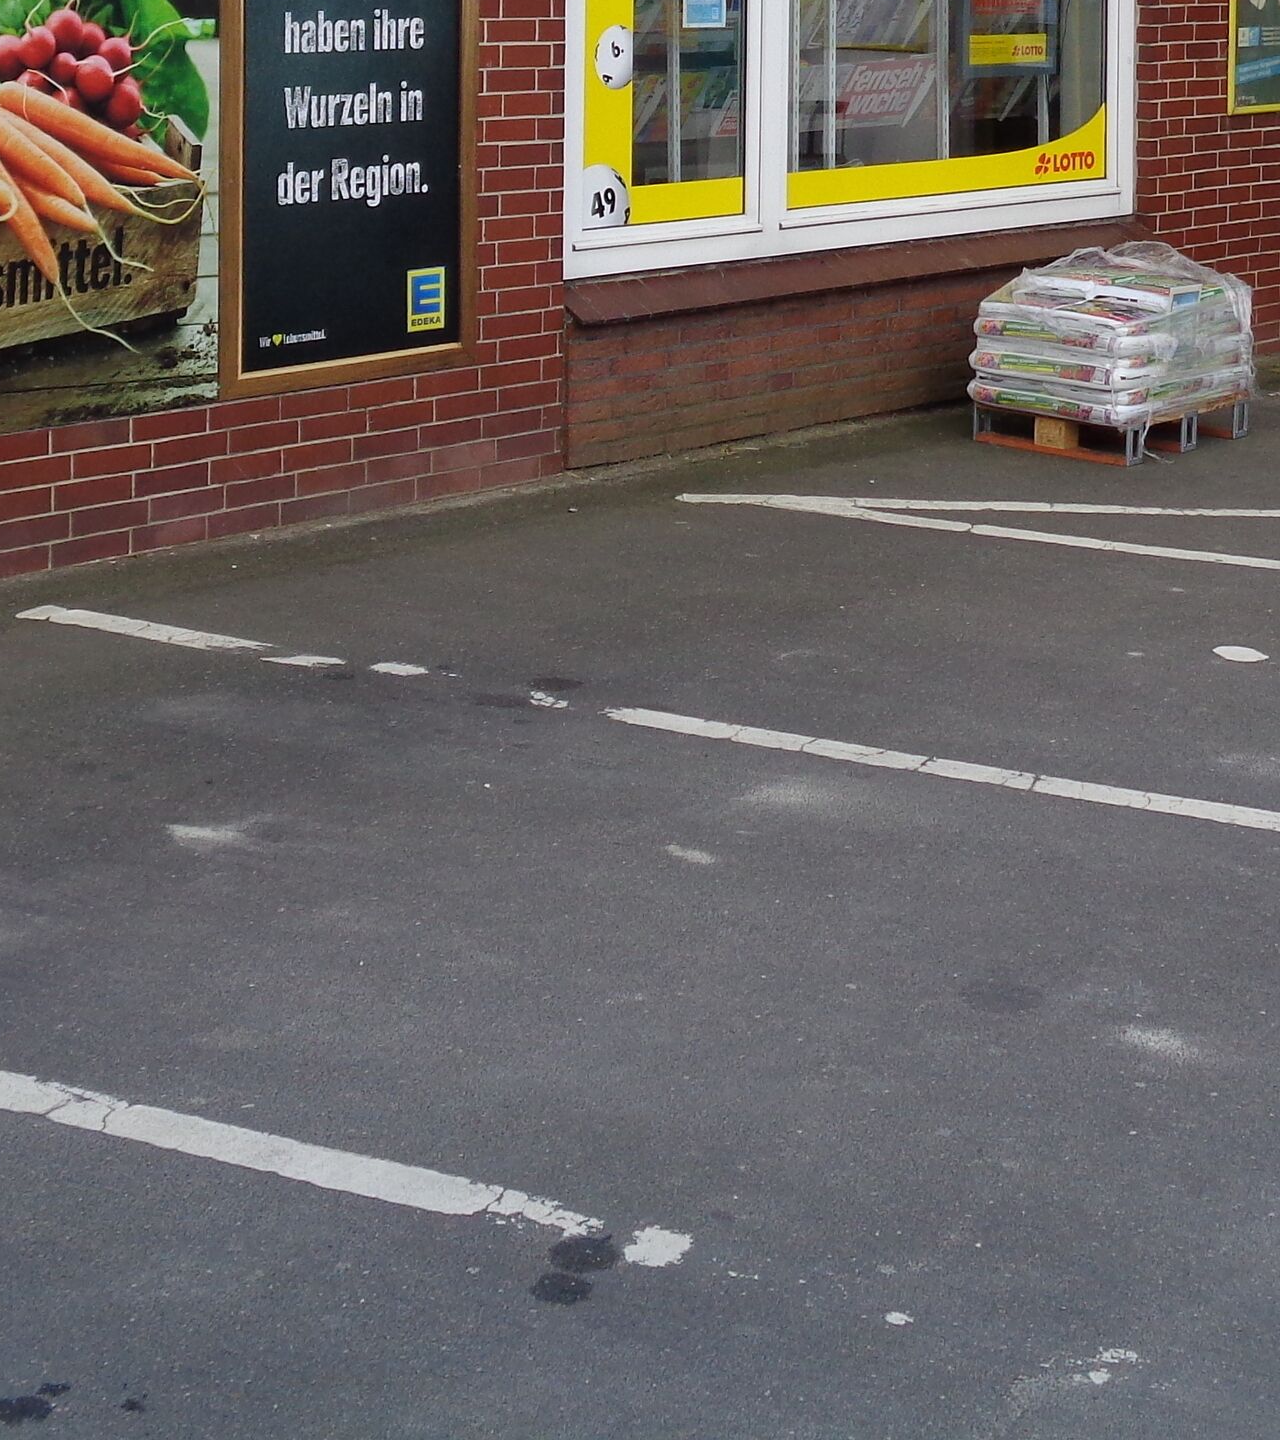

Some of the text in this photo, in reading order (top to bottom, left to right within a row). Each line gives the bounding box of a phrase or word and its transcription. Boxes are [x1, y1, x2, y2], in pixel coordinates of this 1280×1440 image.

[283, 8, 425, 56] haben ihre
[1020, 45, 1044, 57] LOTTO
[283, 81, 423, 130] Wurzeln in
[1051, 150, 1096, 175] LOTTO
[277, 156, 430, 208] der Region.
[590, 187, 617, 219] 49
[411, 316, 442, 328] EDEKA
